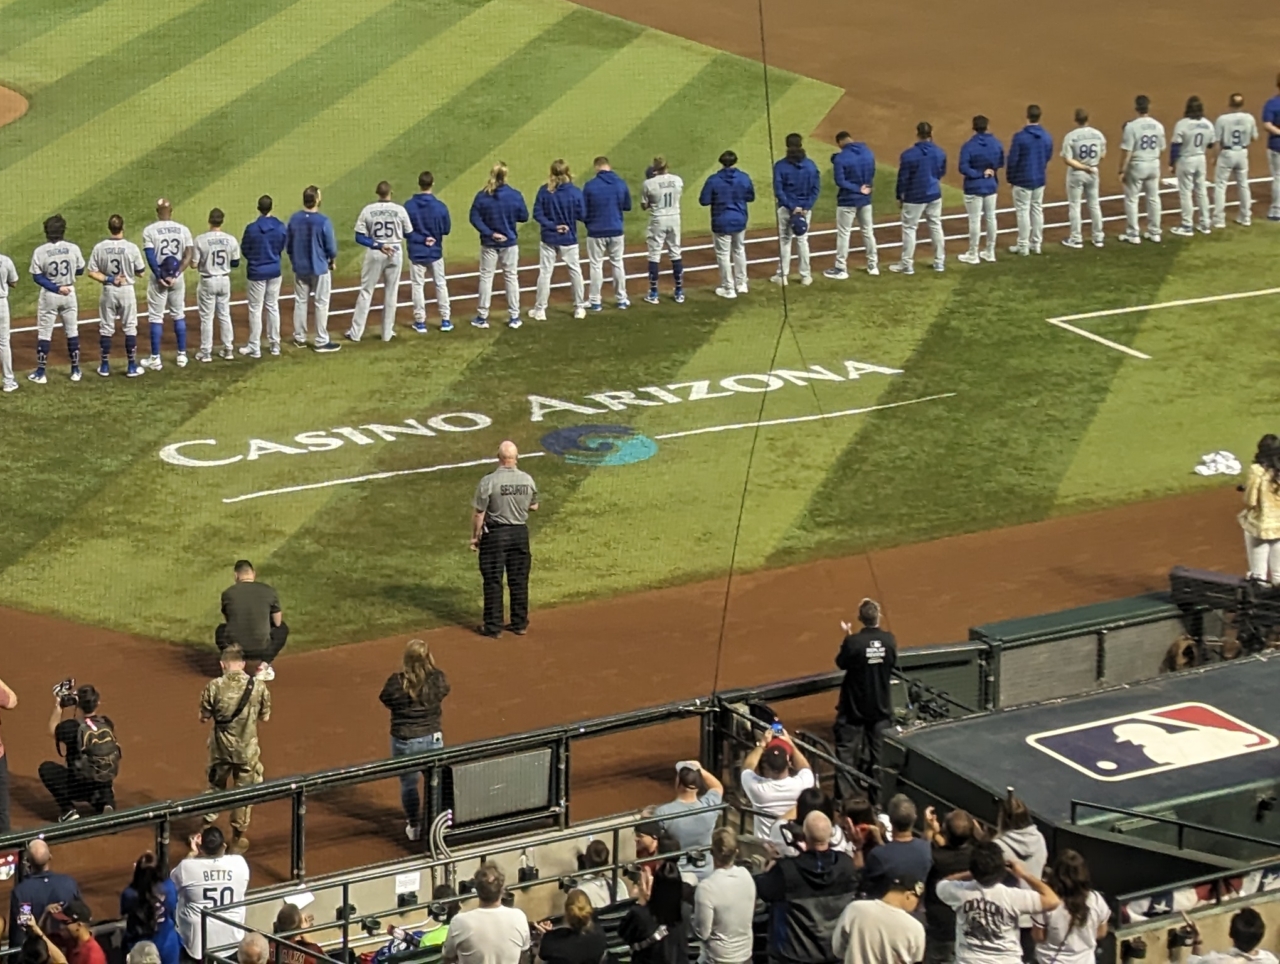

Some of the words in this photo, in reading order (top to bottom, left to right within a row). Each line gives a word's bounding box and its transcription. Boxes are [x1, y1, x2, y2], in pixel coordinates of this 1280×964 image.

[1079, 143, 1098, 159] 86
[663, 192, 672, 208] 11
[374, 221, 395, 238] 25
[160, 238, 180, 256] 23
[212, 249, 226, 266] 15
[48, 260, 70, 278] 33
[110, 259, 120, 275] 3
[159, 411, 493, 467] CASINO
[527, 360, 904, 422] ARIZONA
[203, 869, 233, 882] BETTS
[202, 886, 234, 909] 50
